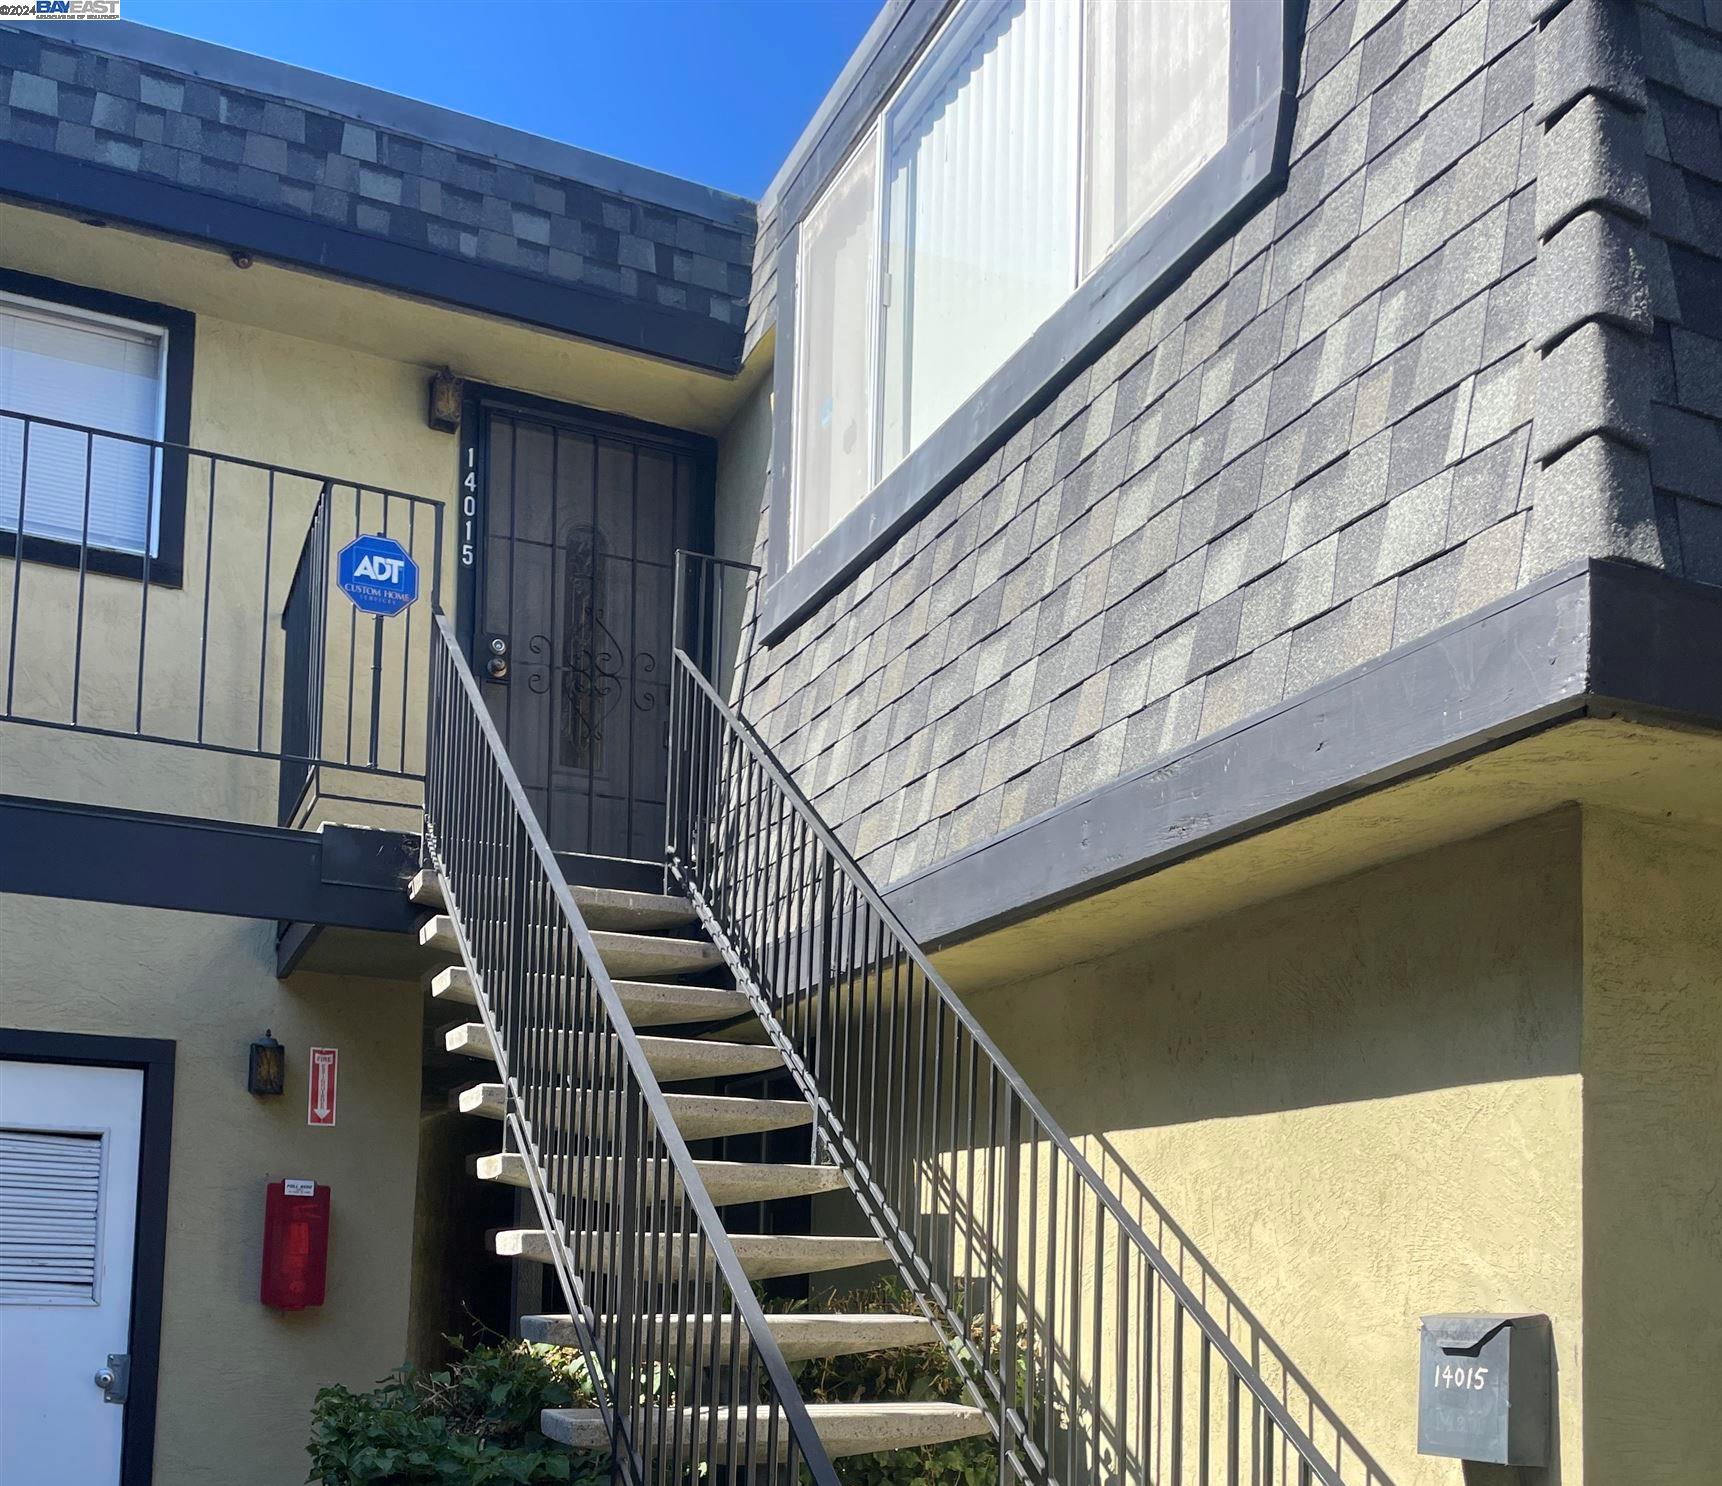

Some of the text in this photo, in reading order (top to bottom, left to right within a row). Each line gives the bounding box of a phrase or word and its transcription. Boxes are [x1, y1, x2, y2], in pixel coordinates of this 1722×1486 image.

[462, 447, 476, 565] 14015
[353, 555, 405, 584] ADT
[344, 583, 410, 602] CUSTOM HOME
[1434, 1365, 1488, 1390] 14015
